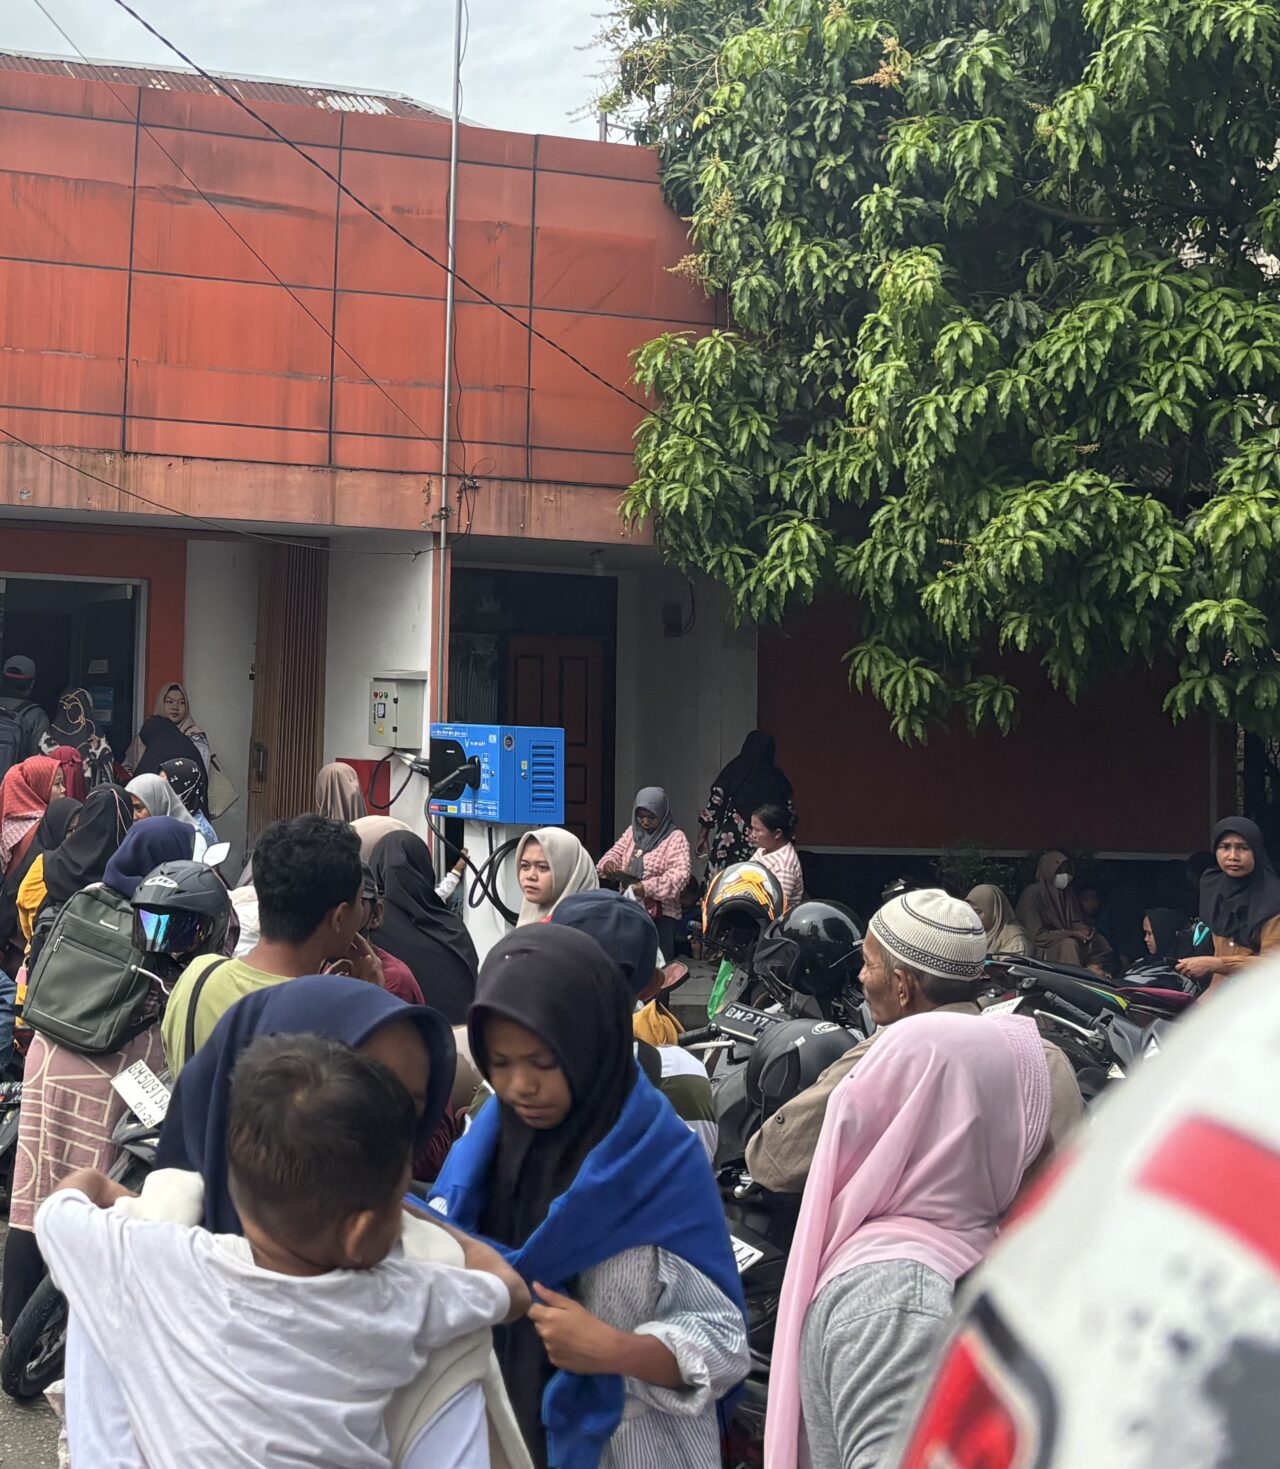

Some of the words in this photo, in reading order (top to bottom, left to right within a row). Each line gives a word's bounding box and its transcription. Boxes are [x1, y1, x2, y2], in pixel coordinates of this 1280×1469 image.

[725, 1007, 744, 1020] BM
[128, 1063, 145, 1080] BM
[137, 1074, 163, 1098] 5091
